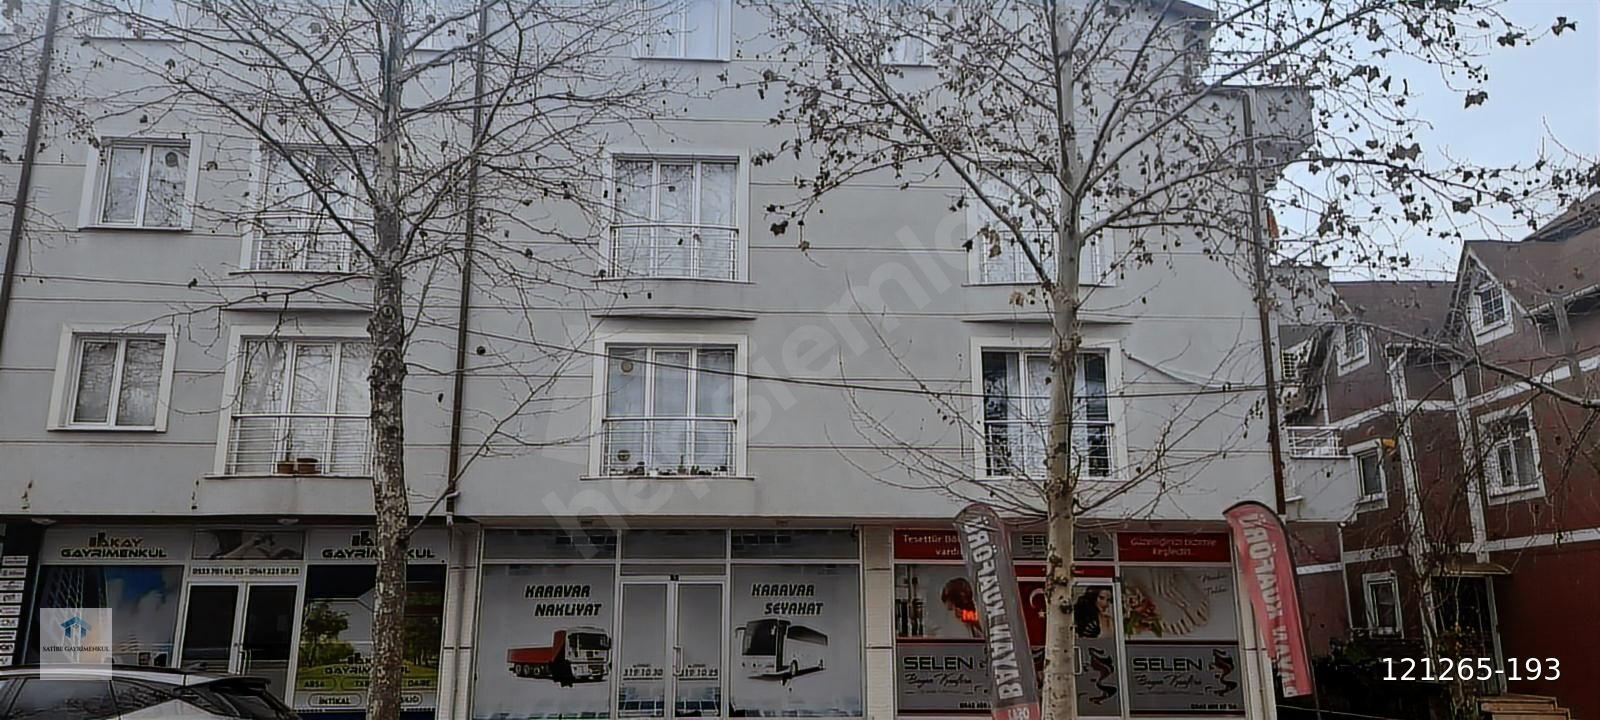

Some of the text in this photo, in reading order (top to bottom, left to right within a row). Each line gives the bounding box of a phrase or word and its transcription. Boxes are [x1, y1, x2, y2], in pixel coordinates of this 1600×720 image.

[764, 602, 824, 615] SEYAHAT
[904, 656, 973, 669] SELEN
[1133, 657, 1203, 671] SELEN
